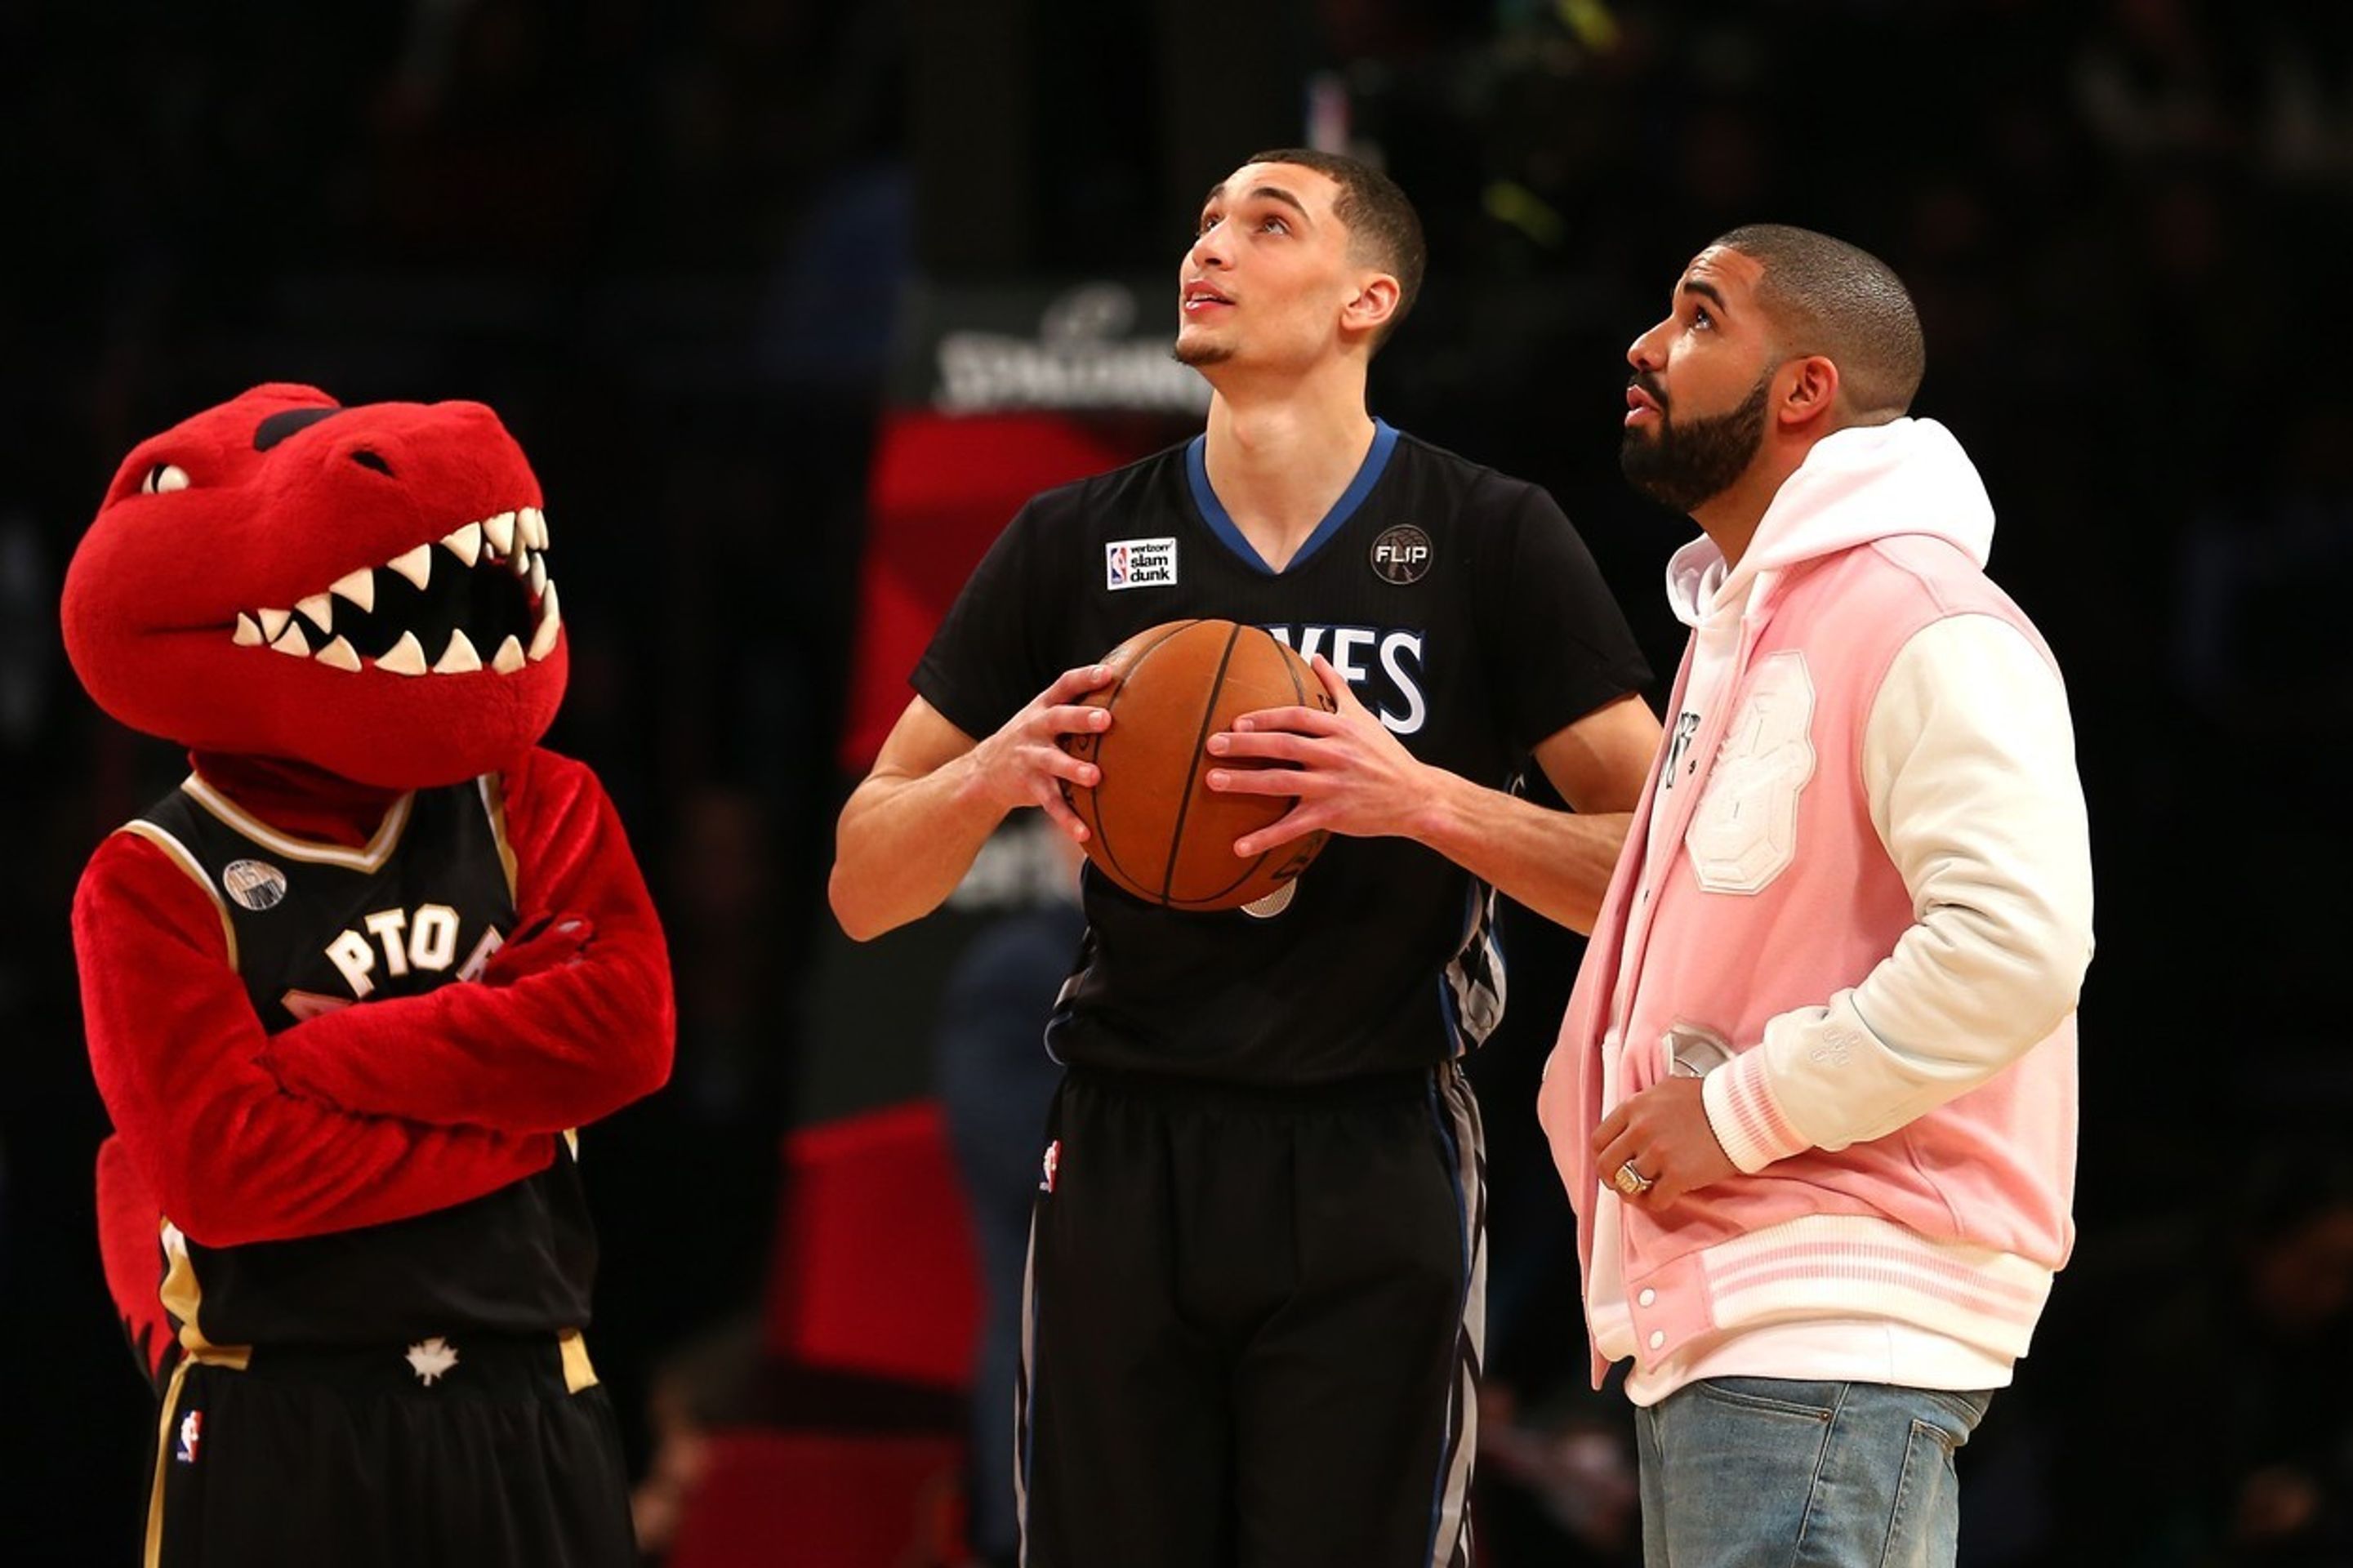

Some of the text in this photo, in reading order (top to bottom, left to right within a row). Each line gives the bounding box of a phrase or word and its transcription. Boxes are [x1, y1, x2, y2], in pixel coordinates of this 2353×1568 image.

[1130, 554, 1169, 569] slam
[1376, 546, 1428, 564] FLIP
[1130, 567, 1170, 583] dunk
